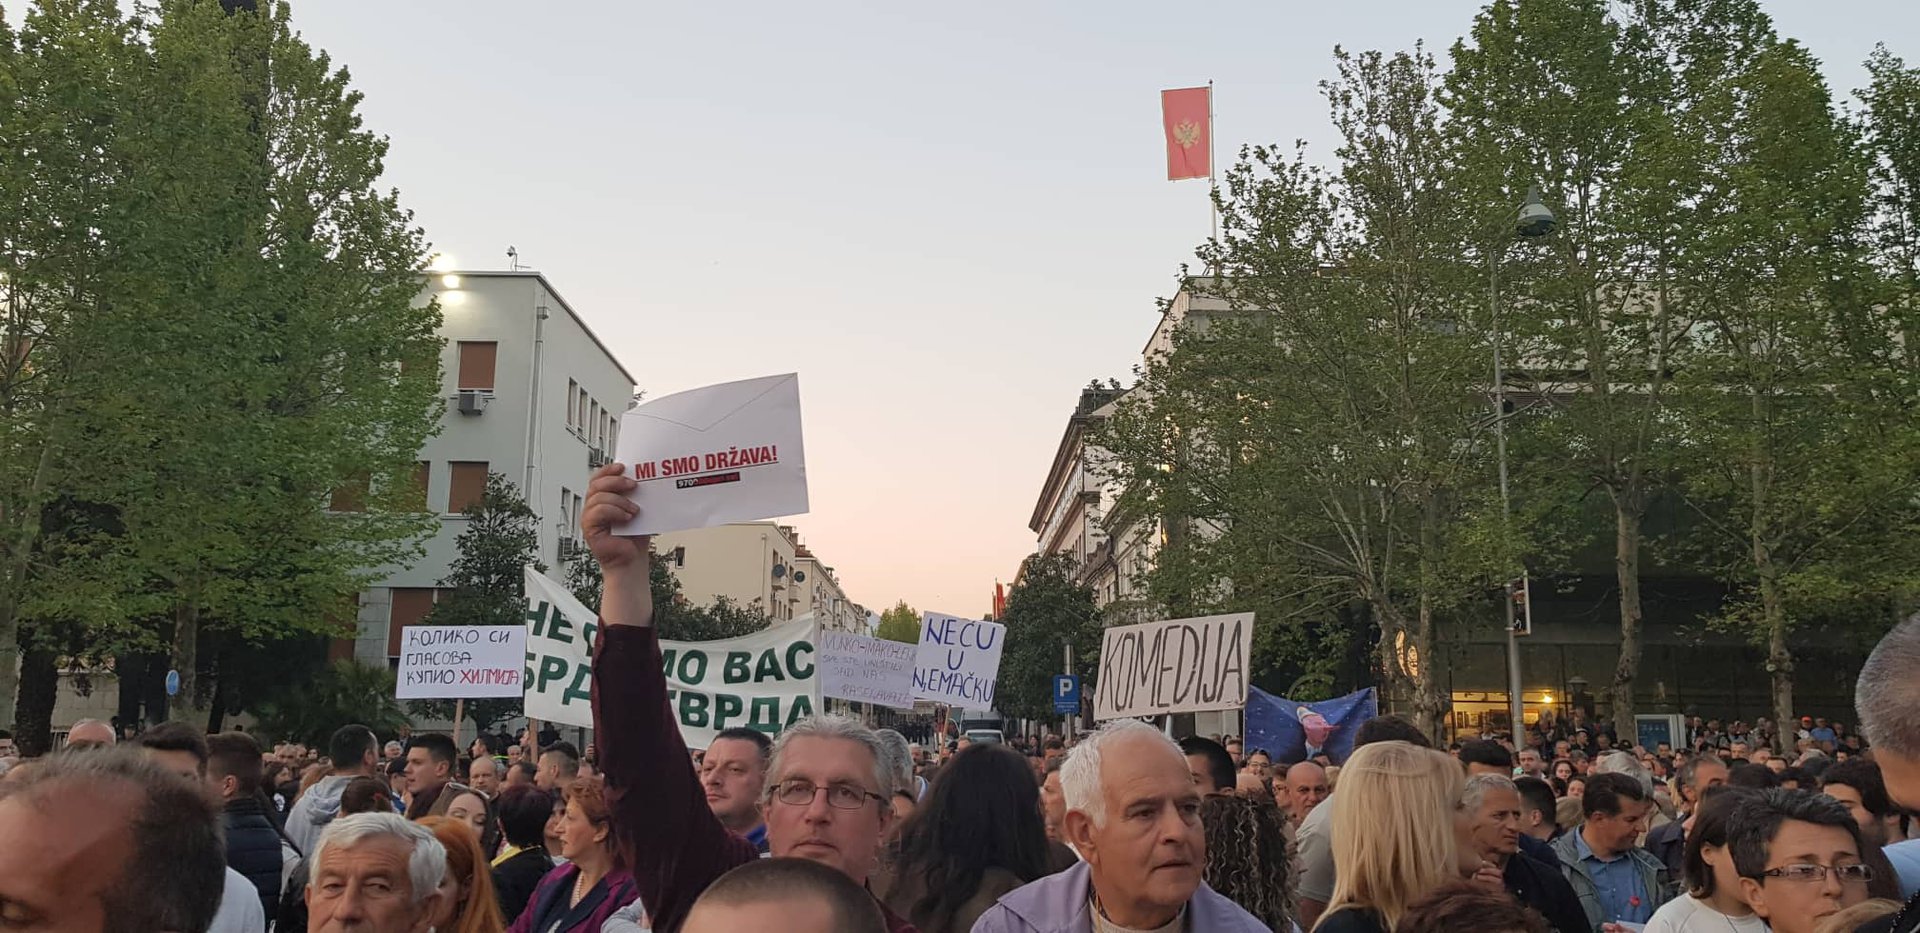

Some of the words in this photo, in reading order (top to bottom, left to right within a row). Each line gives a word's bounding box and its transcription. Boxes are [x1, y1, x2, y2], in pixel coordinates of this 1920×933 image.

[635, 462, 656, 479] MI
[662, 456, 699, 476] SMO
[705, 445, 777, 470] DRŽAVA!
[409, 629, 480, 646] КОЛИКО
[489, 630, 510, 643] СИ
[926, 618, 996, 650] NEĆU
[406, 651, 472, 665] ГЛАСОВА
[723, 641, 814, 684] ВАС
[947, 648, 964, 670] U
[1099, 620, 1244, 712] KOMEDIJA
[406, 669, 455, 685] КУПИО
[1060, 679, 1073, 697] P
[667, 689, 814, 740] ВРДА
